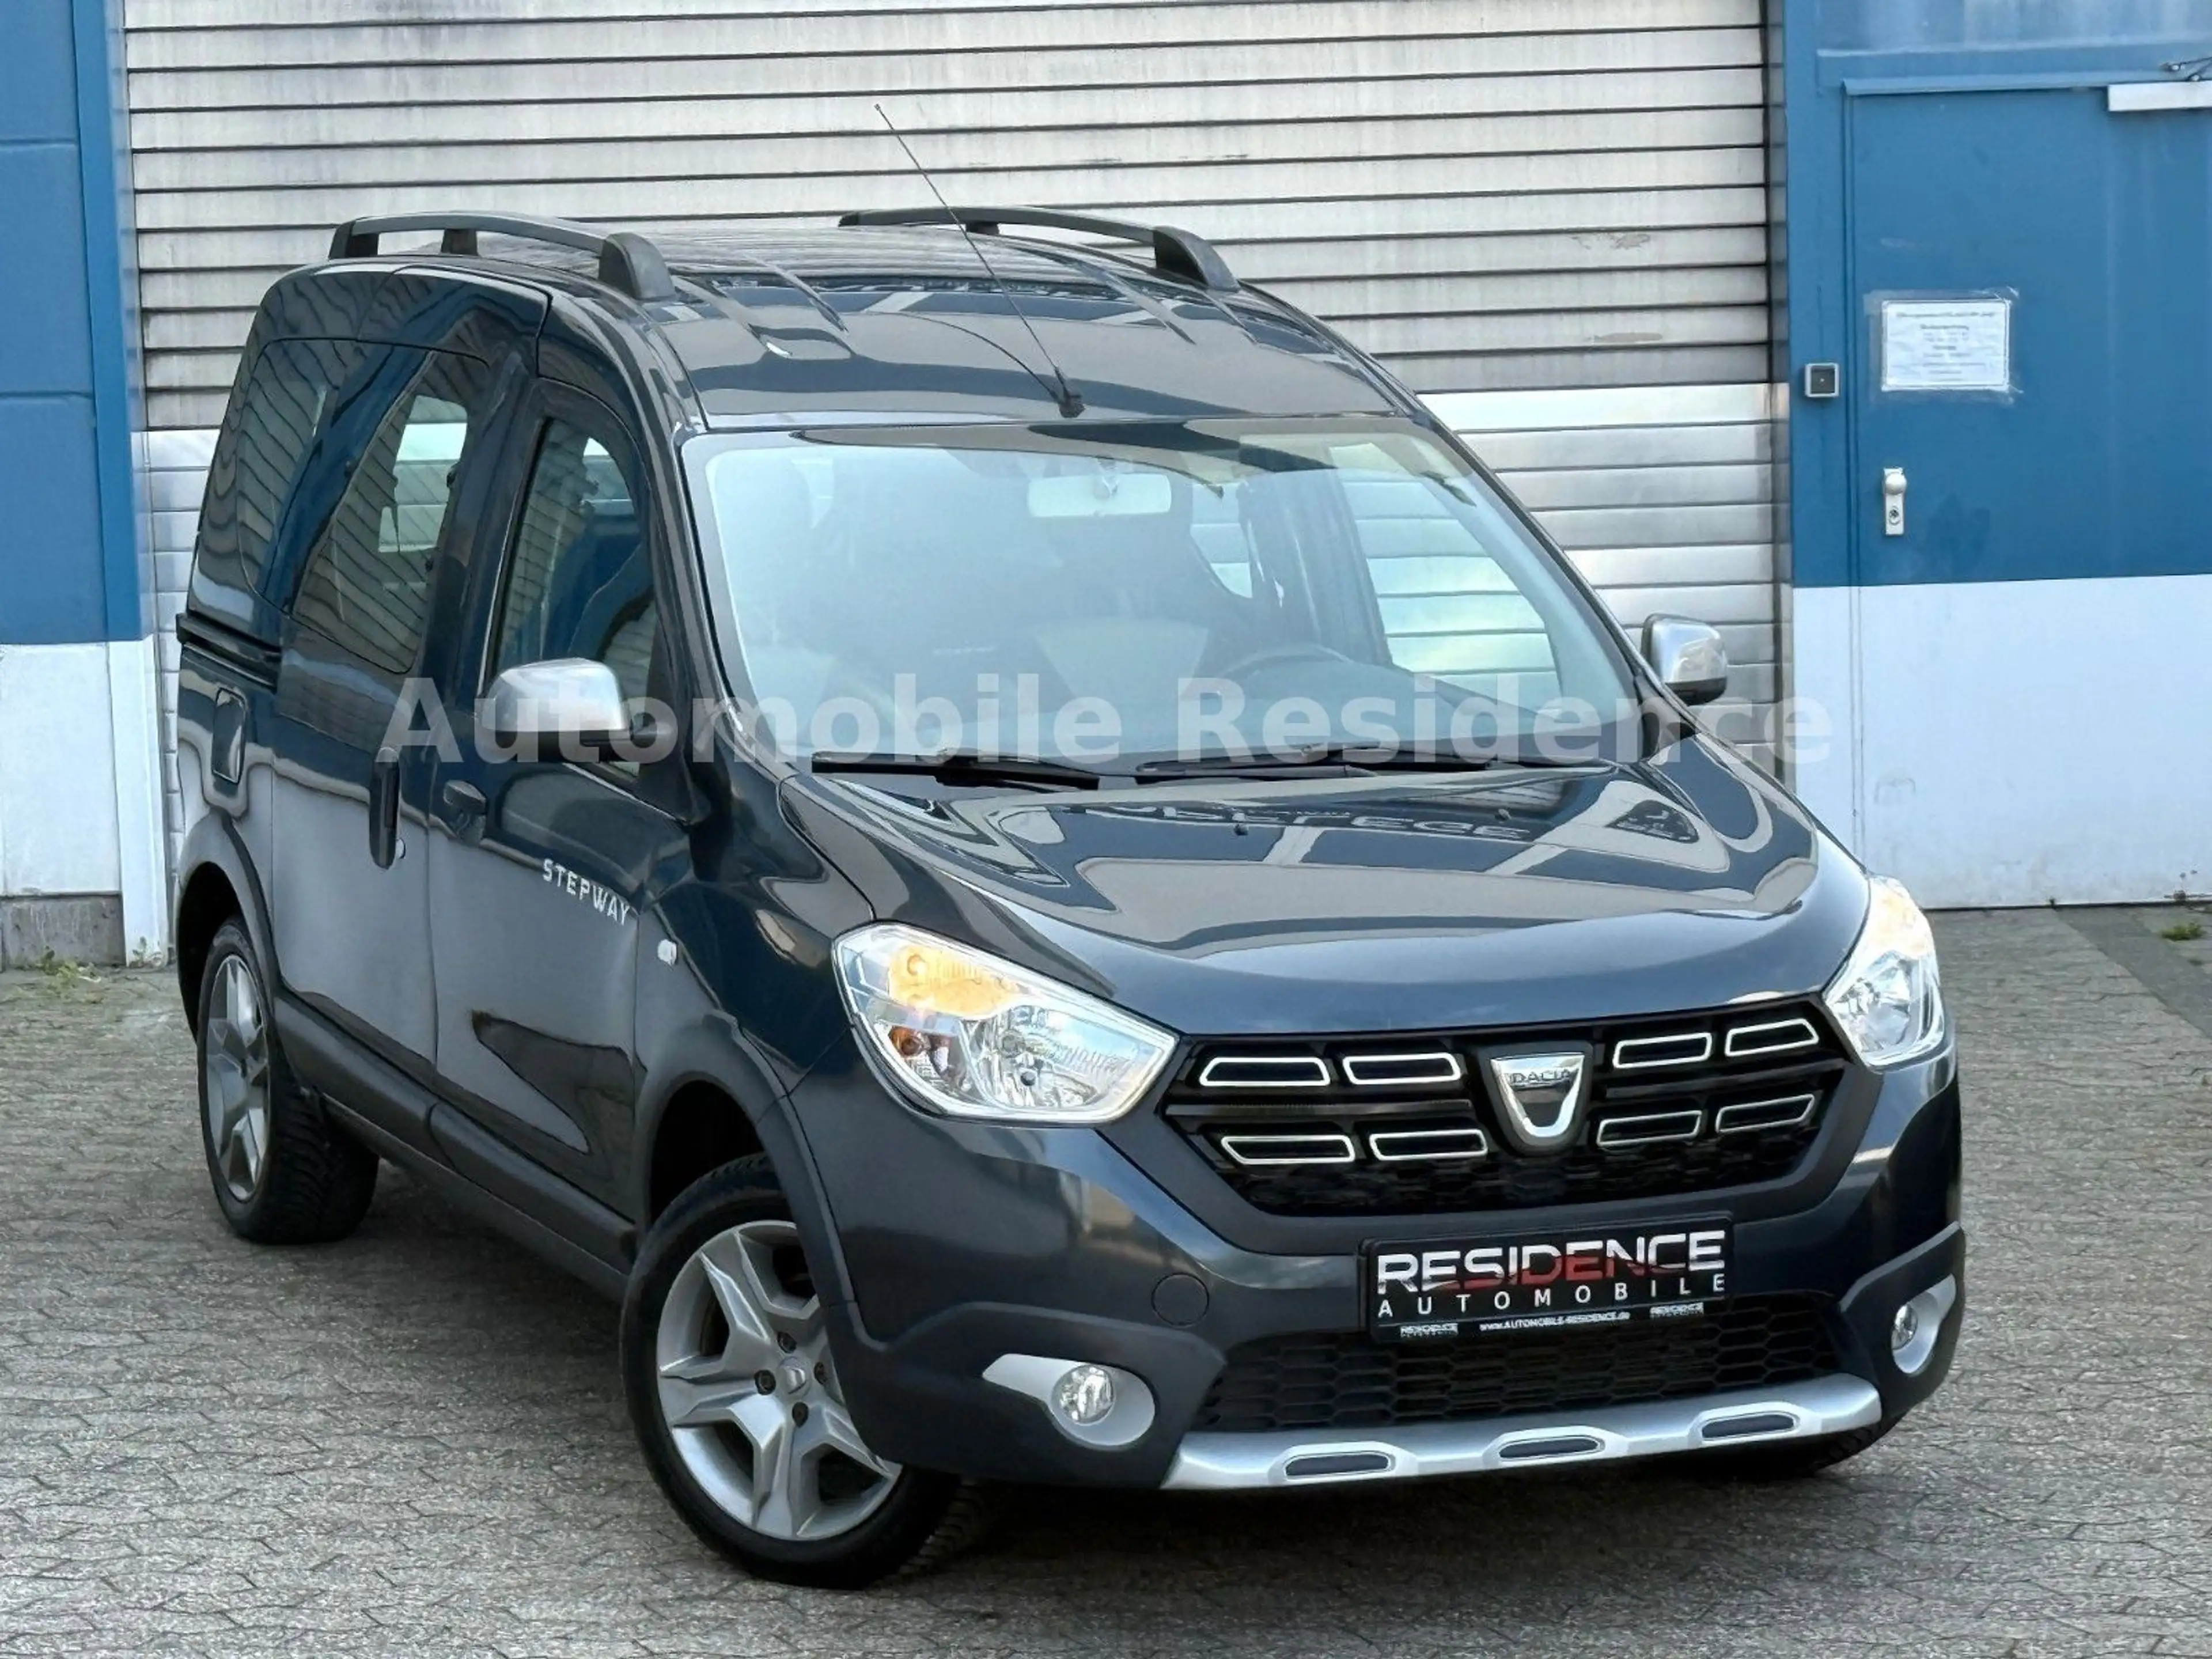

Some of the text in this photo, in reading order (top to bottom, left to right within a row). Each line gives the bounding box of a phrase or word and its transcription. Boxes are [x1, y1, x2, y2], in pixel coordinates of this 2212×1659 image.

[543, 858, 630, 926] STEPWAY
[1512, 1068, 1571, 1083] DACIA
[1377, 1230, 1725, 1294] RESIDENCE
[1378, 1273, 1725, 1318] AUTOMOBILE
